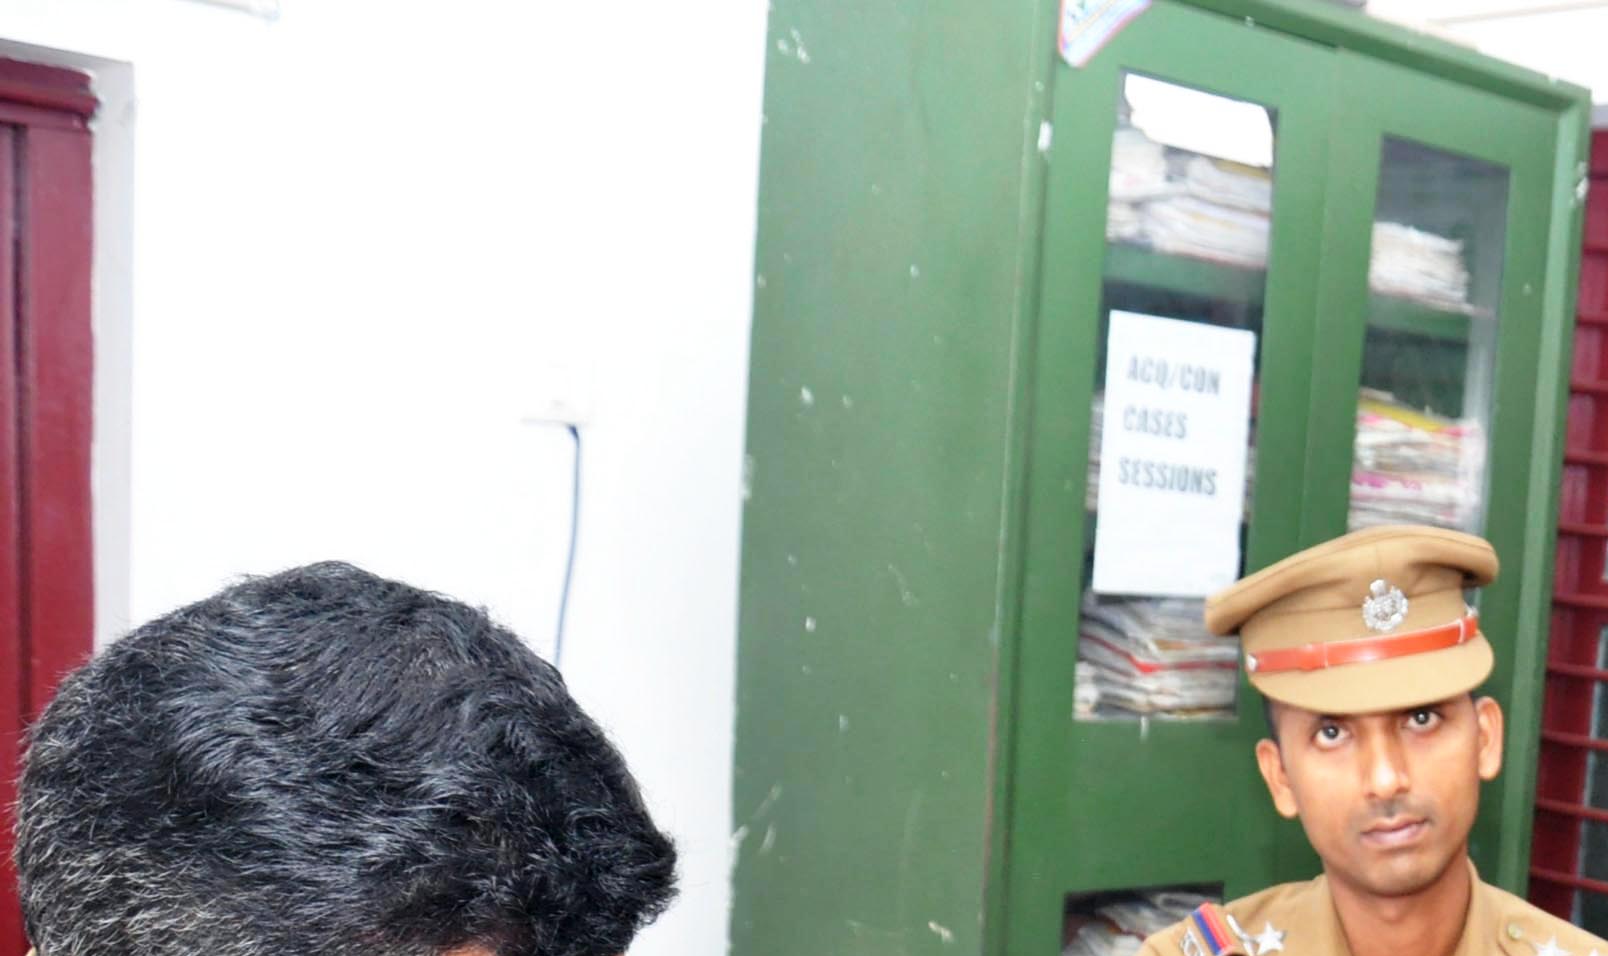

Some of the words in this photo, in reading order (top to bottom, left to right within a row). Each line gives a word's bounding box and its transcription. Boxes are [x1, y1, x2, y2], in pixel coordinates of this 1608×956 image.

[1127, 354, 1221, 395] ACQ/CON
[1122, 404, 1188, 440] CASES
[1117, 457, 1218, 496] SESSIONS
